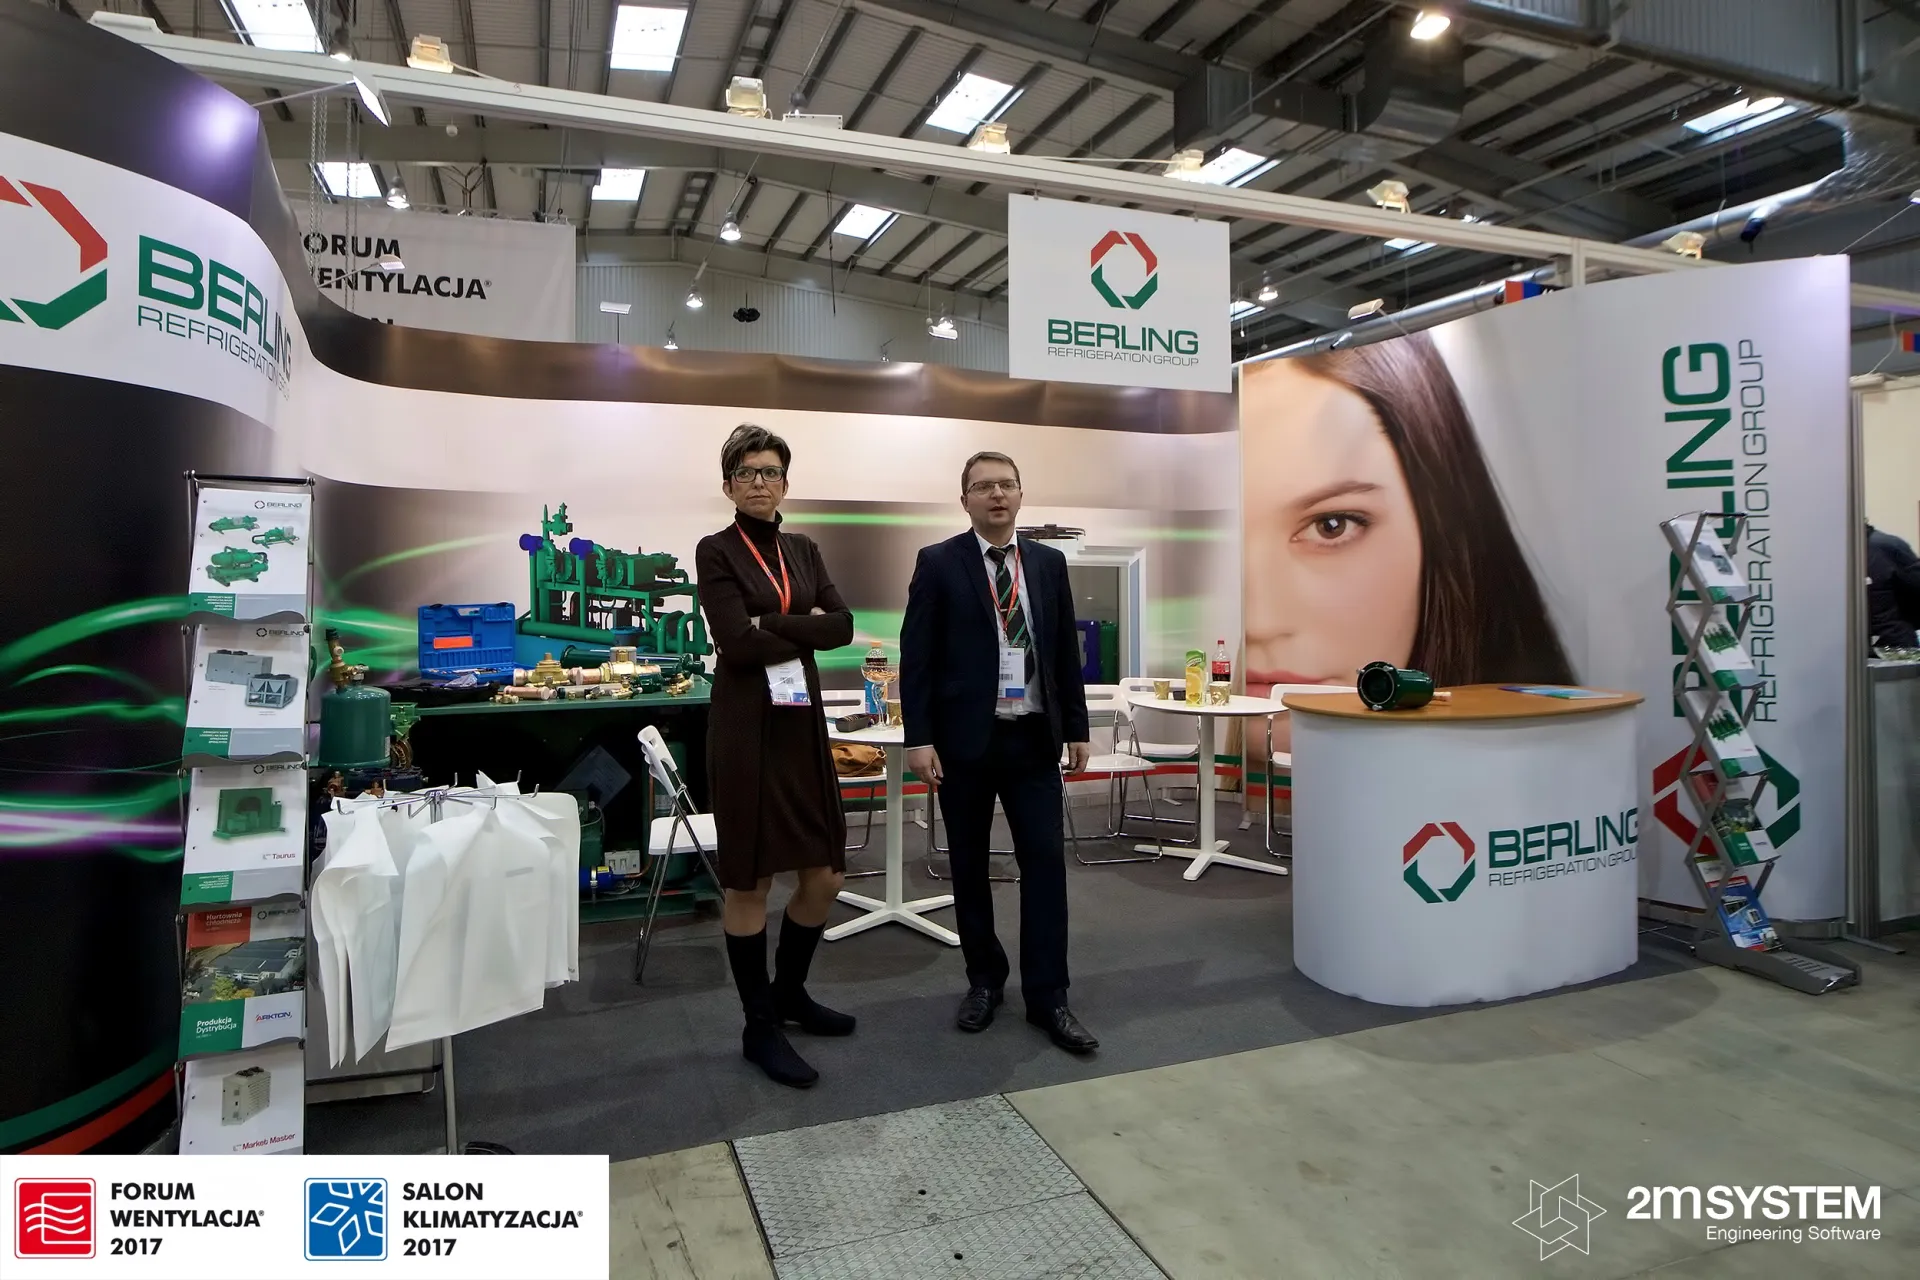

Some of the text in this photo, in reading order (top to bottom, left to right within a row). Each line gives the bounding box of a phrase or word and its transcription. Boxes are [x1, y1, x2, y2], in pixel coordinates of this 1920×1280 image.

[300, 231, 401, 259] ORUM
[311, 267, 492, 300] ENTYLACJA®
[139, 234, 292, 383] BERLING
[1047, 318, 1199, 355] BERLING
[1047, 346, 1199, 367] REFRIGERATION GROUP
[1738, 338, 1768, 456] GROUP
[1488, 807, 1638, 869] BERLING
[1488, 856, 1607, 887] REFRIGERATION
[196, 1022, 237, 1034] Dystrybucja
[197, 1016, 232, 1027] Produkcja
[242, 1133, 296, 1150] Market Master
